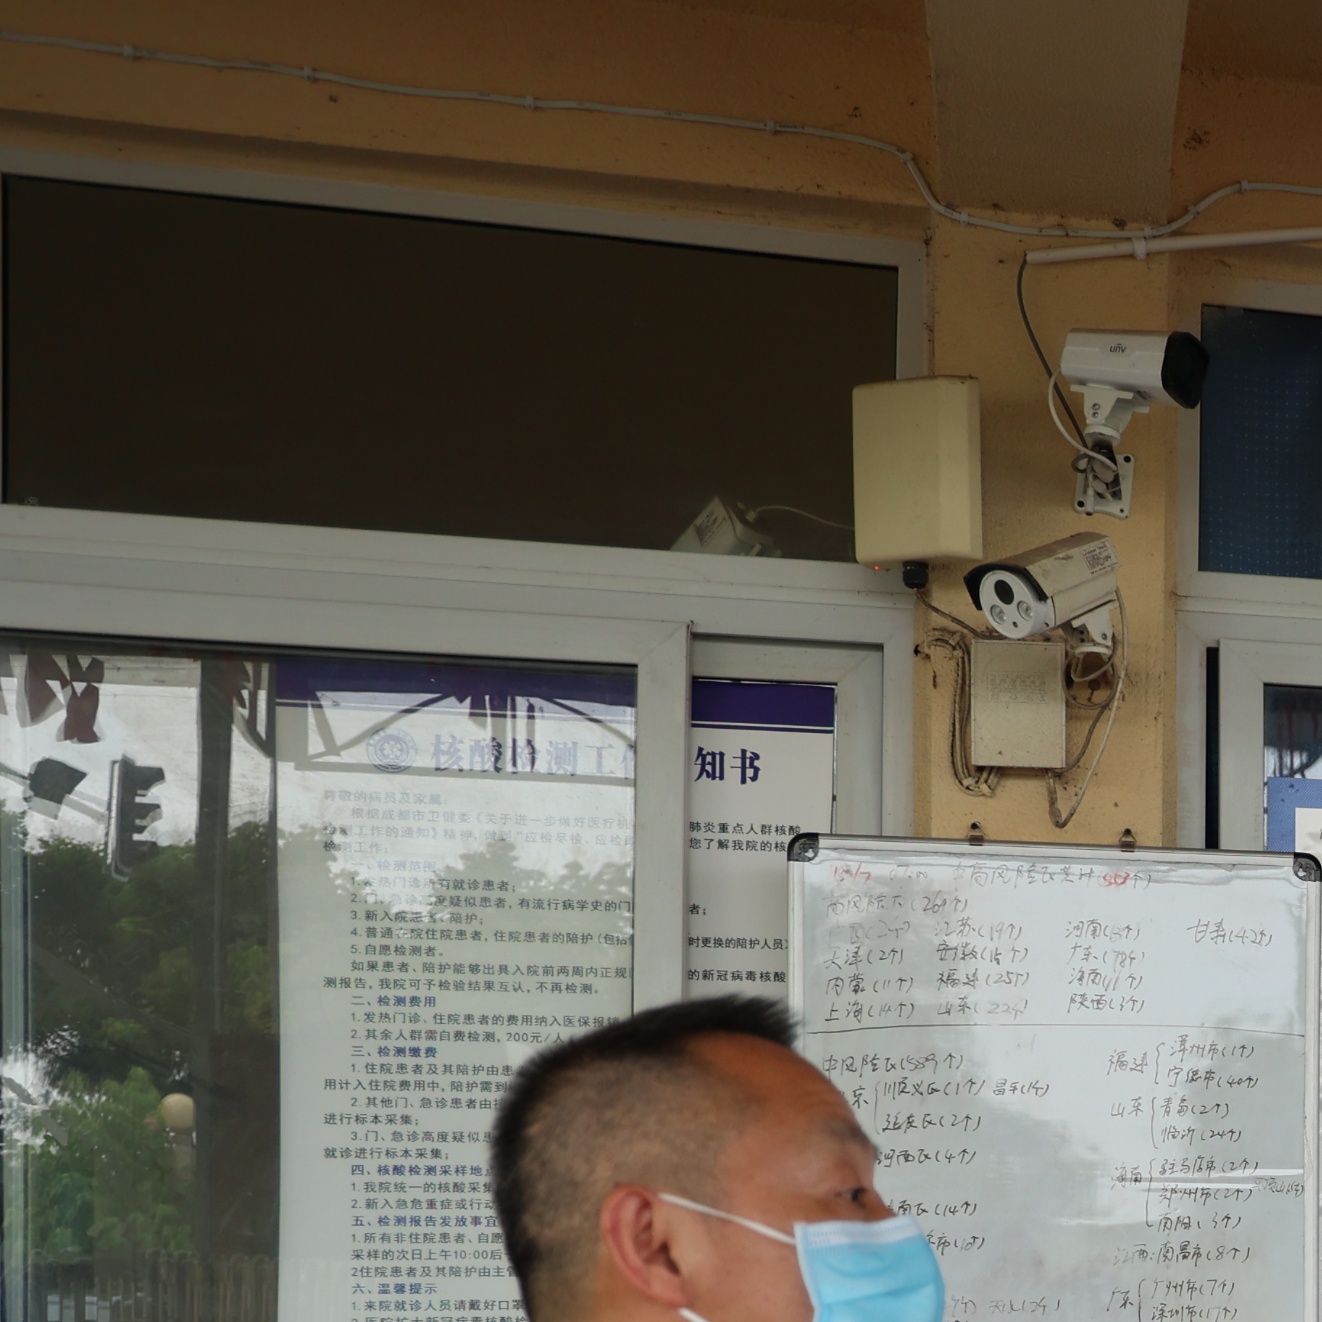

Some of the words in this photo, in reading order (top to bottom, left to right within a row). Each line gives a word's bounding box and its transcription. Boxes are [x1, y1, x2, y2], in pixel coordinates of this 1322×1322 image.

[693, 747, 761, 785] 知书
[689, 821, 801, 836] 肺炎重点人群核酸
[689, 838, 786, 852] 您了解我院的核
[351, 960, 634, 979] 如果患者、陪护能够出具入院前两周内正规
[688, 969, 787, 983] 的新冠病毒核酸
[351, 996, 437, 1007] 二、检测费用
[351, 1046, 437, 1058] 三、检测缴费
[323, 1079, 512, 1094] 用计入住院费用中，陪护需到
[351, 1249, 511, 1261] 采样的次日上午10:00后
[352, 1283, 437, 1295] 六、温馨提示
